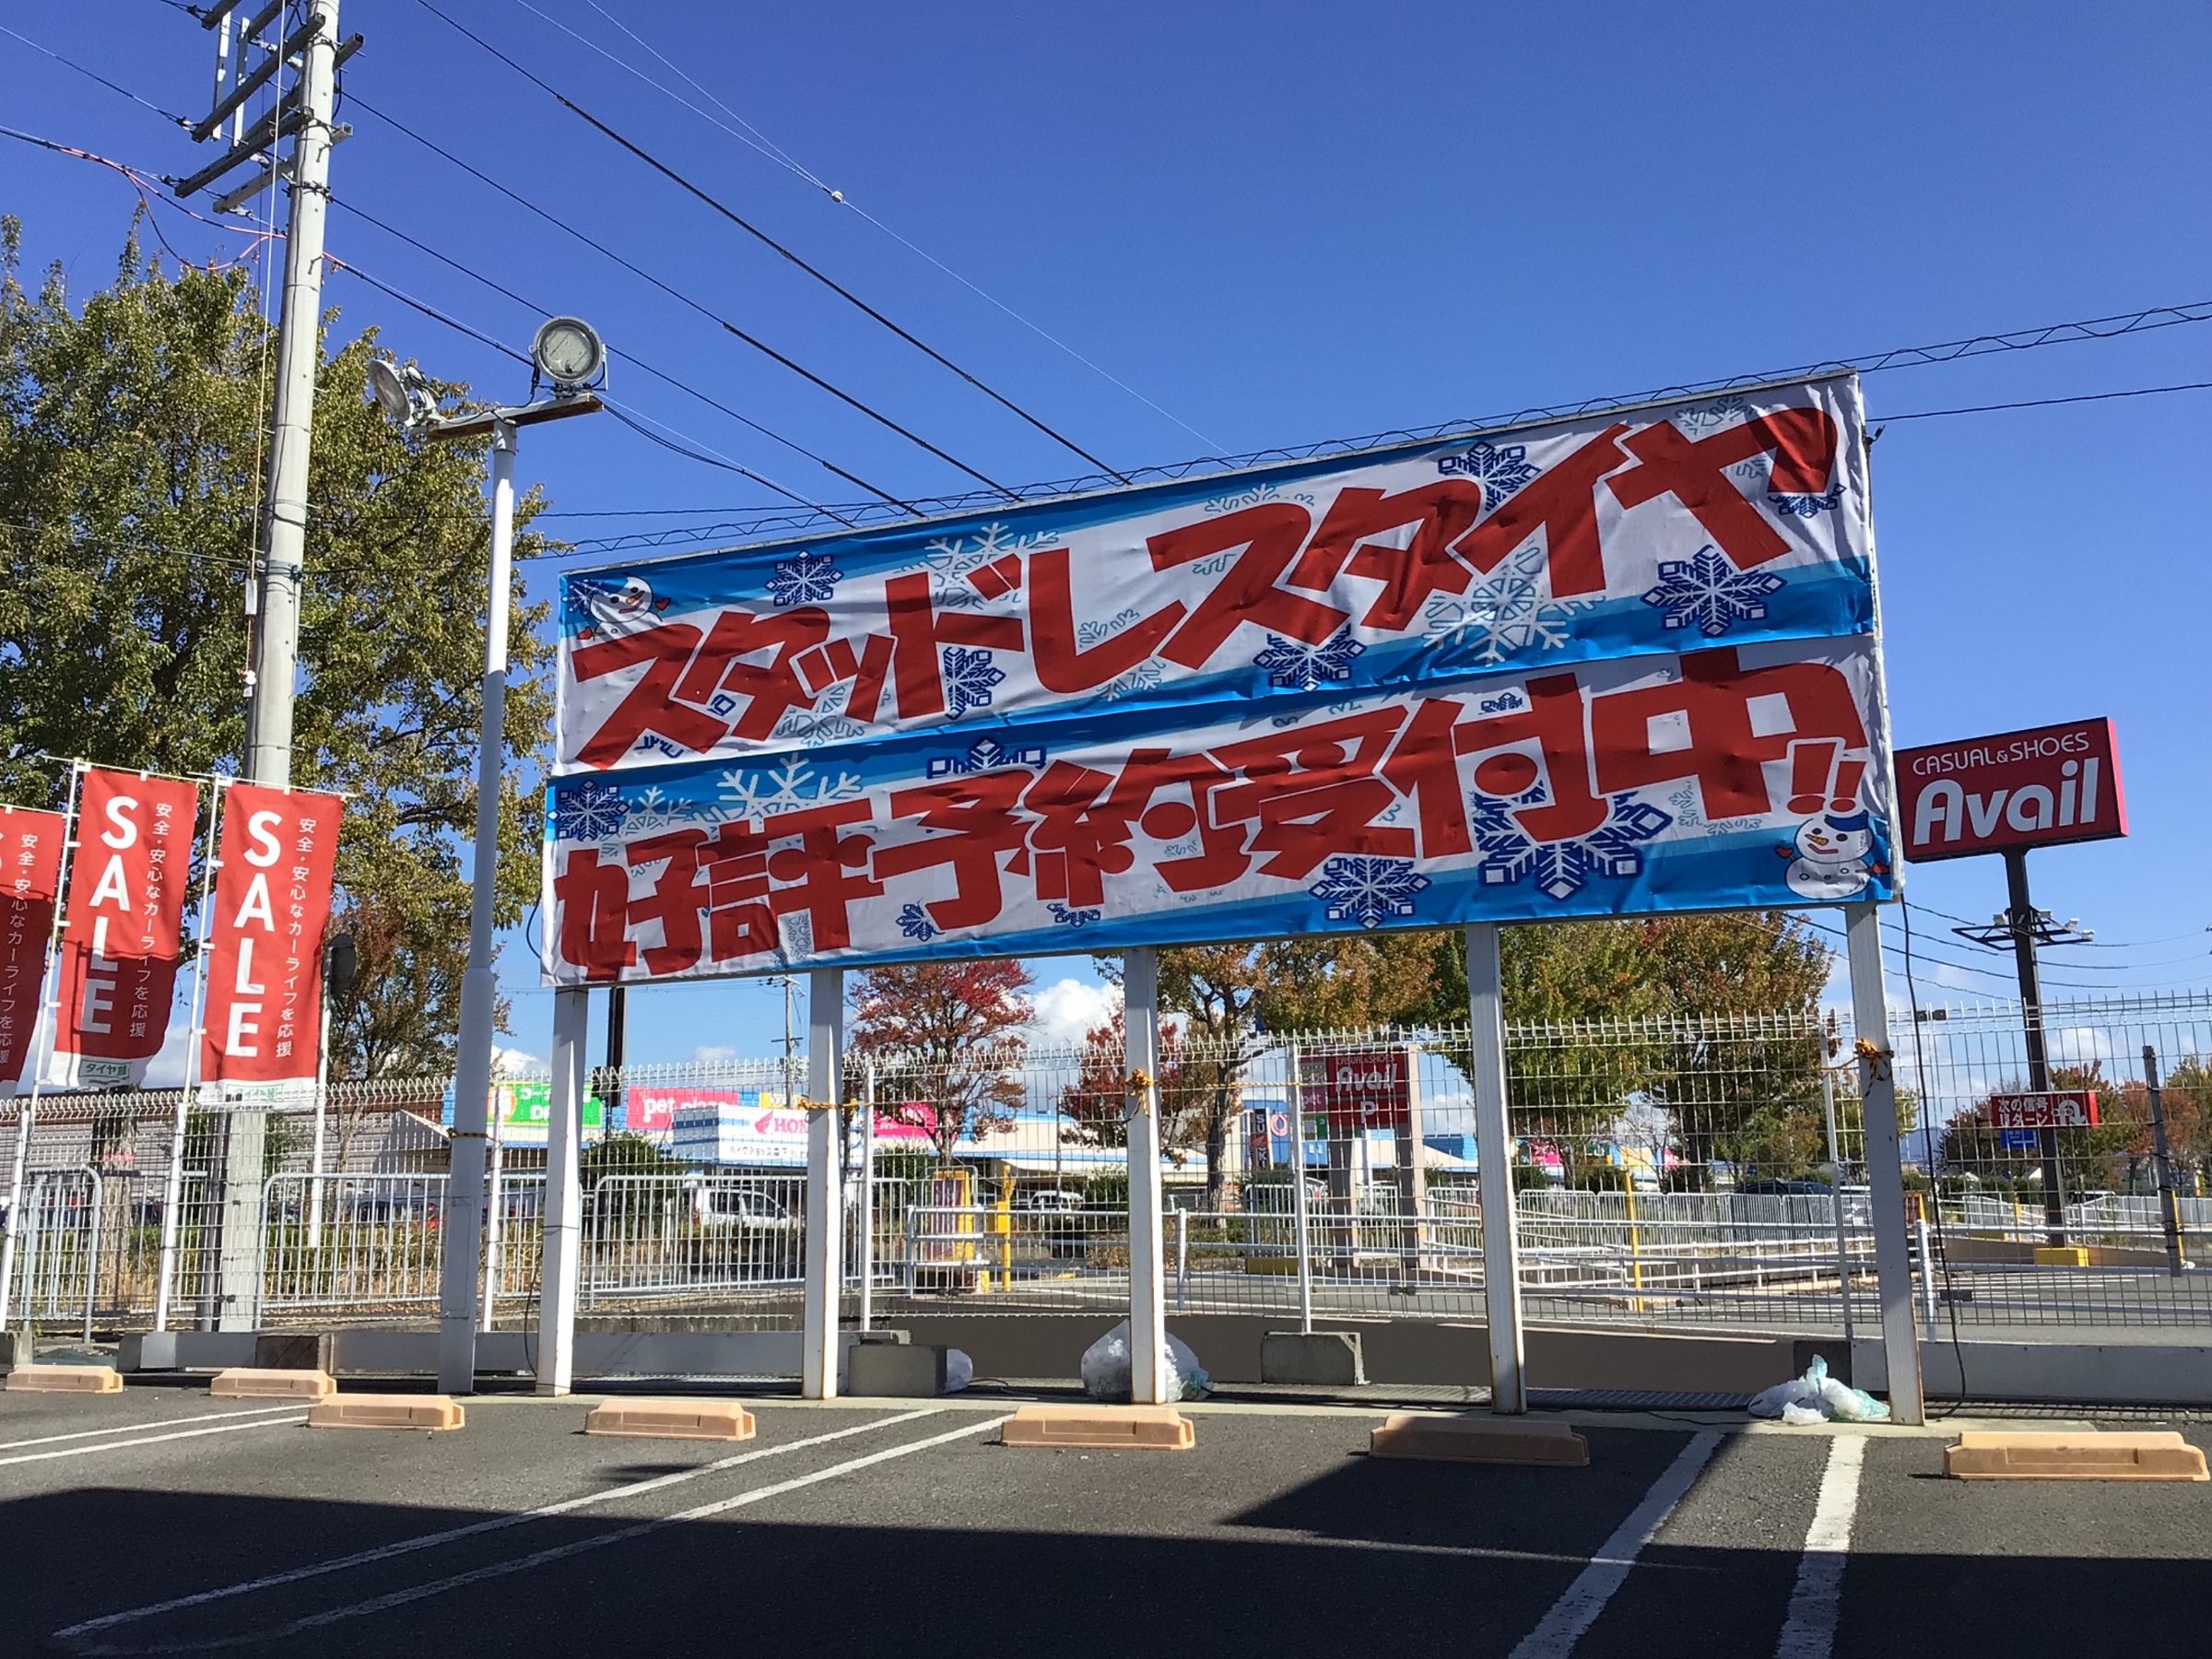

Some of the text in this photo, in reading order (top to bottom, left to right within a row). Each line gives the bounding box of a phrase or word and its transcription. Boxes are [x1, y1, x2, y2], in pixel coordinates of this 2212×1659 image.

[571, 406, 1838, 771] スタッドレスタイヤ
[1912, 731, 2090, 776] CASUAL&SHOES
[1912, 757, 2100, 847] Avail
[79, 795, 139, 1034] SALE
[129, 802, 173, 1039] 安全・安心なカーライフを応援
[224, 809, 283, 1058] SALE
[276, 818, 317, 1058] 安全・安心なカーライフを応援
[643, 1096, 676, 1124] pet
[1335, 1063, 1398, 1092] Avail
[1359, 1100, 1376, 1124] P
[1998, 1097, 2048, 1112] 次の信号
